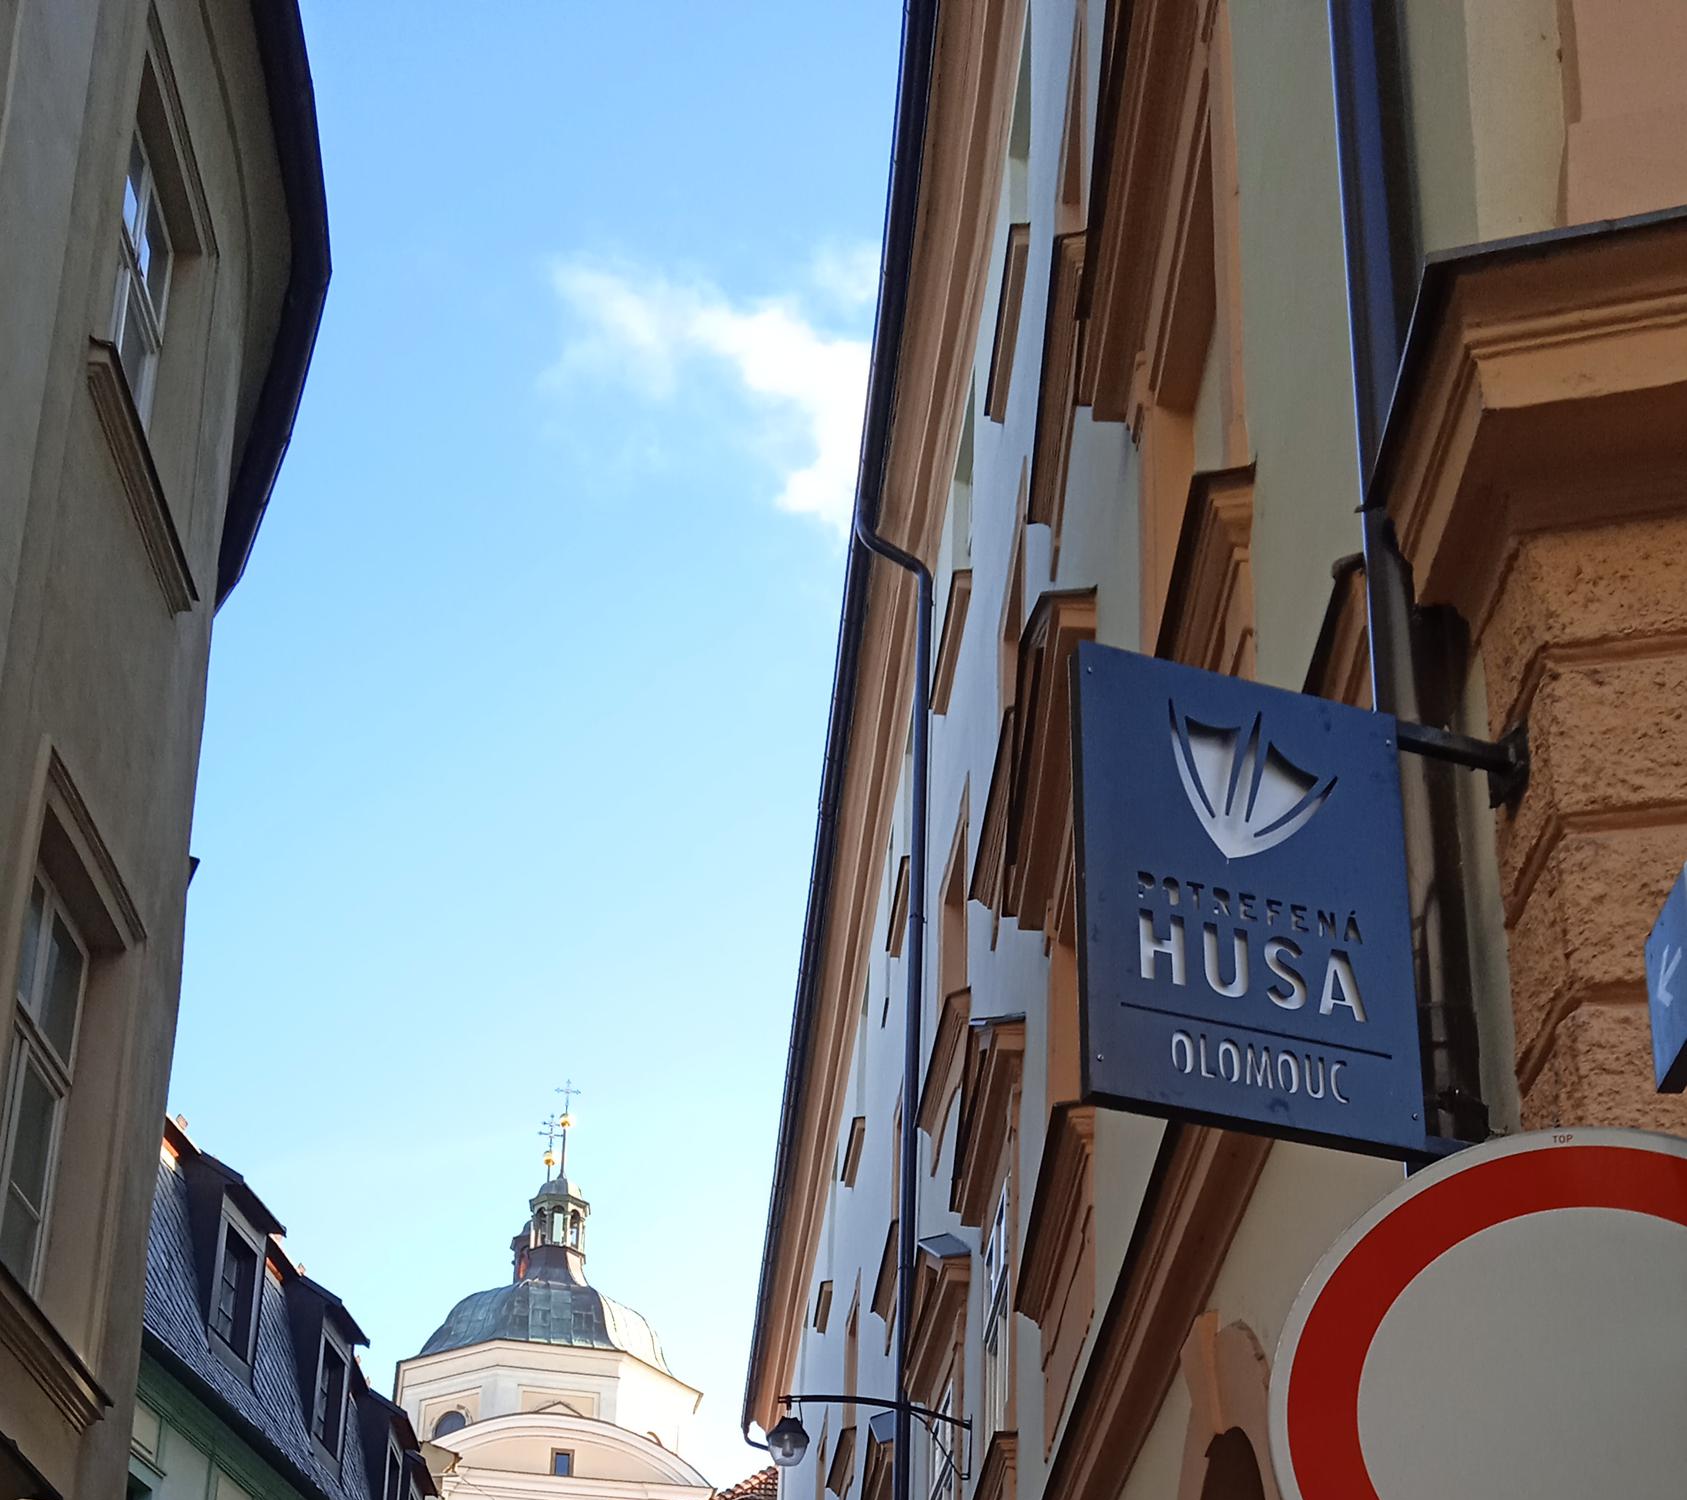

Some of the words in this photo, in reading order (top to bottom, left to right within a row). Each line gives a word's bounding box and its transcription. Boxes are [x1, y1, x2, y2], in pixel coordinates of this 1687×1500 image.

[1136, 870, 1364, 945] POTREFENÁ
[1138, 907, 1368, 1024] HUSA
[1171, 1028, 1351, 1105] OLOMOUC
[1552, 1134, 1574, 1144] TOP
